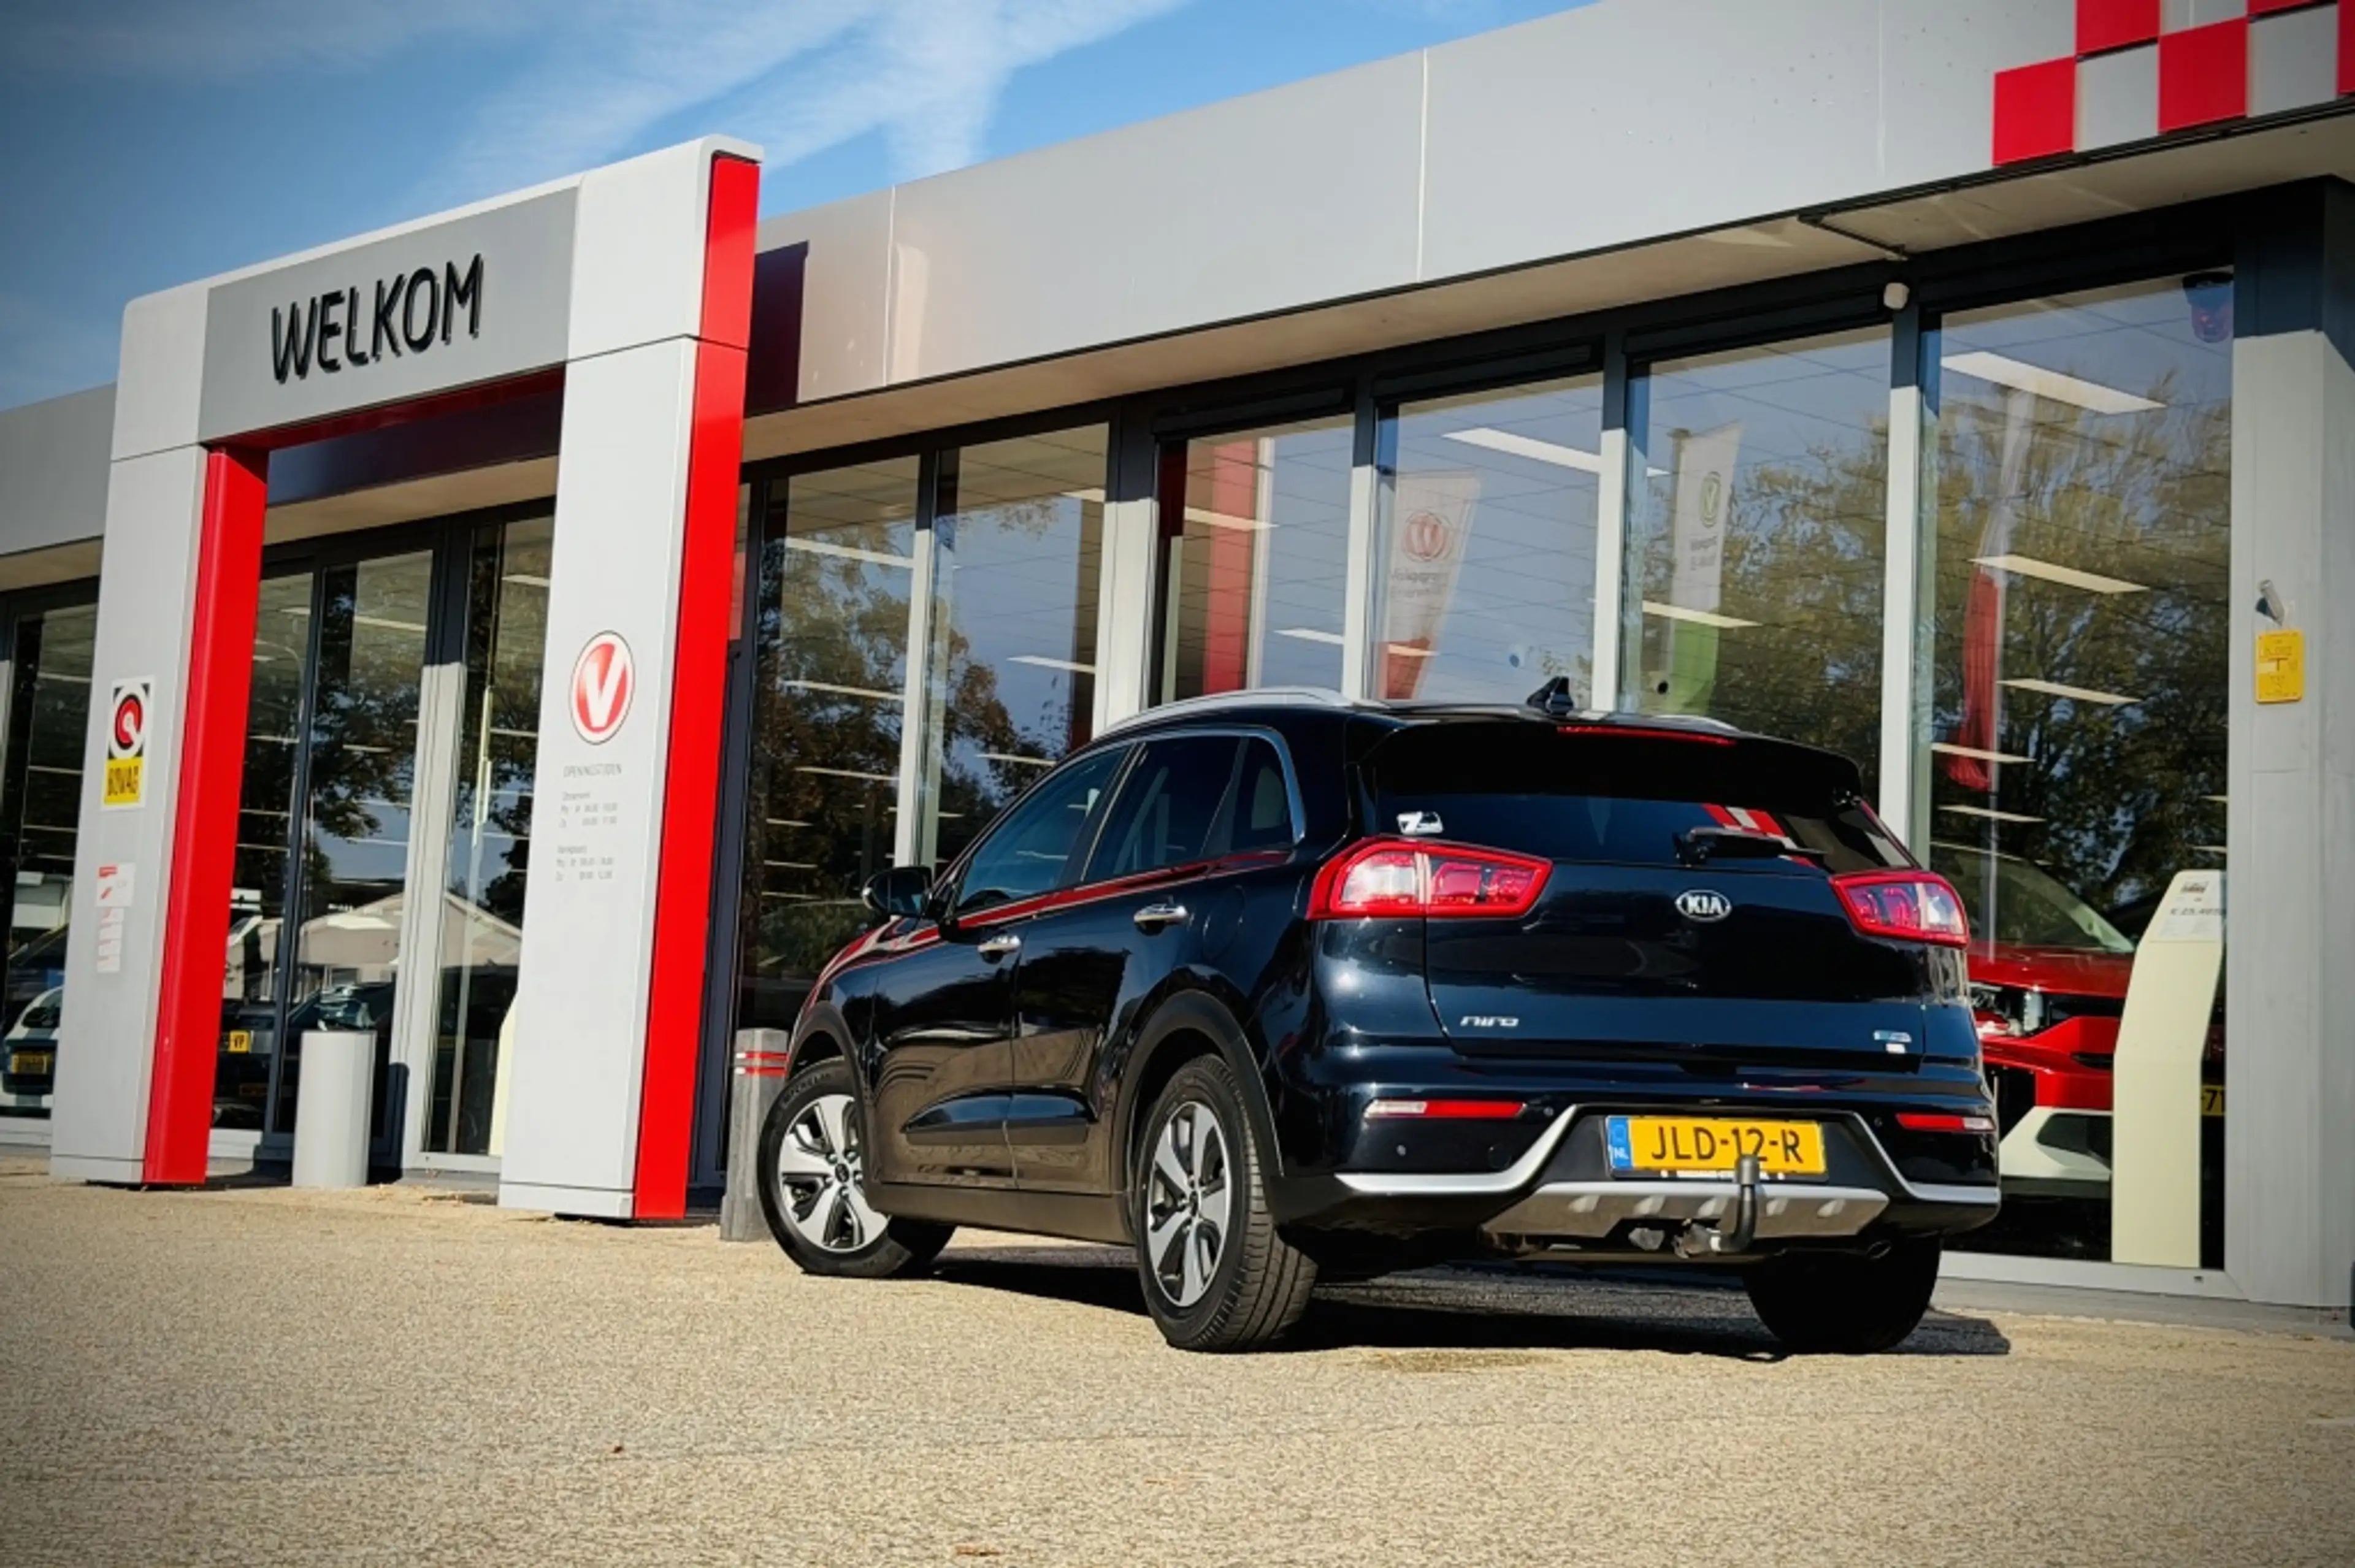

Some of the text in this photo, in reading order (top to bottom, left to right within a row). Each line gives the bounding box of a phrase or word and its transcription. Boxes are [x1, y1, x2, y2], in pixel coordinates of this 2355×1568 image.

[272, 253, 484, 384] WELKOM
[1687, 894, 1725, 914] KIA
[1614, 1146, 1629, 1160] NL
[1651, 1126, 1803, 1163] JLD-12-R
